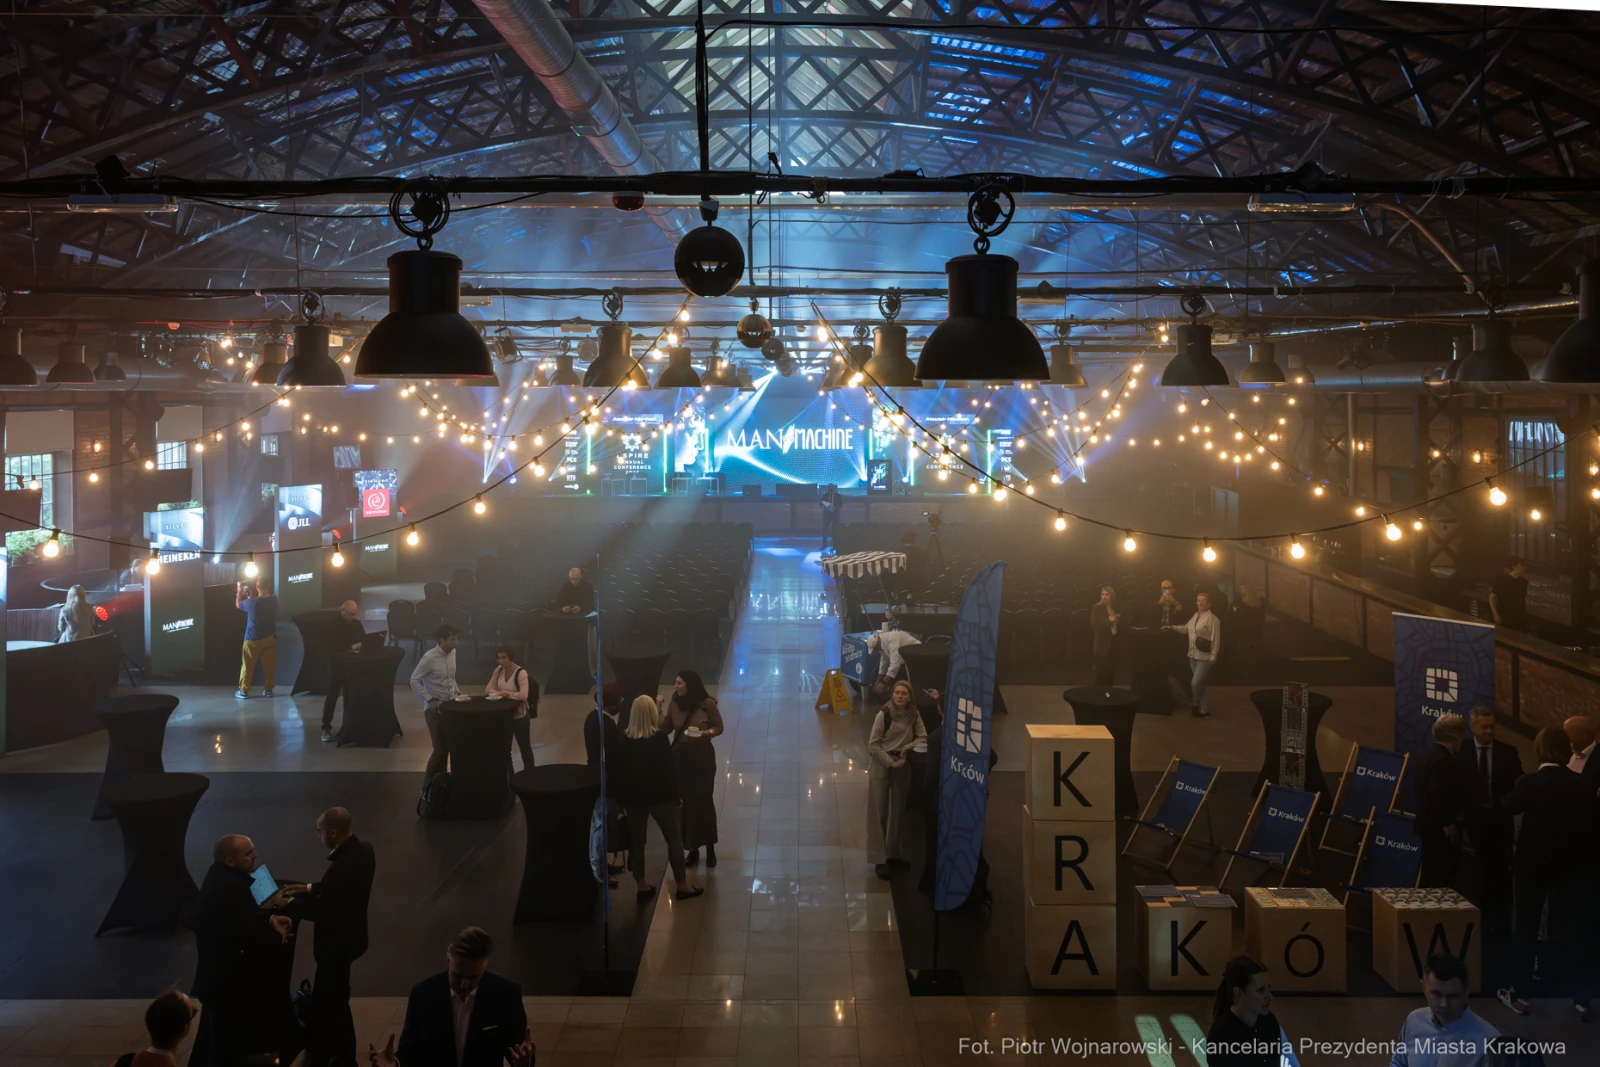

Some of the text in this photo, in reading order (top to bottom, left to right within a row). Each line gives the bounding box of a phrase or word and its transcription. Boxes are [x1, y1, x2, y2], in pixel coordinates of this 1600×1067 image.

[727, 428, 854, 450] MAN MACHINE
[1053, 751, 1093, 808] K
[1366, 768, 1396, 781] Kraków
[1278, 810, 1305, 823] Kraków
[1387, 839, 1418, 852] Kraków
[1054, 835, 1095, 891] R
